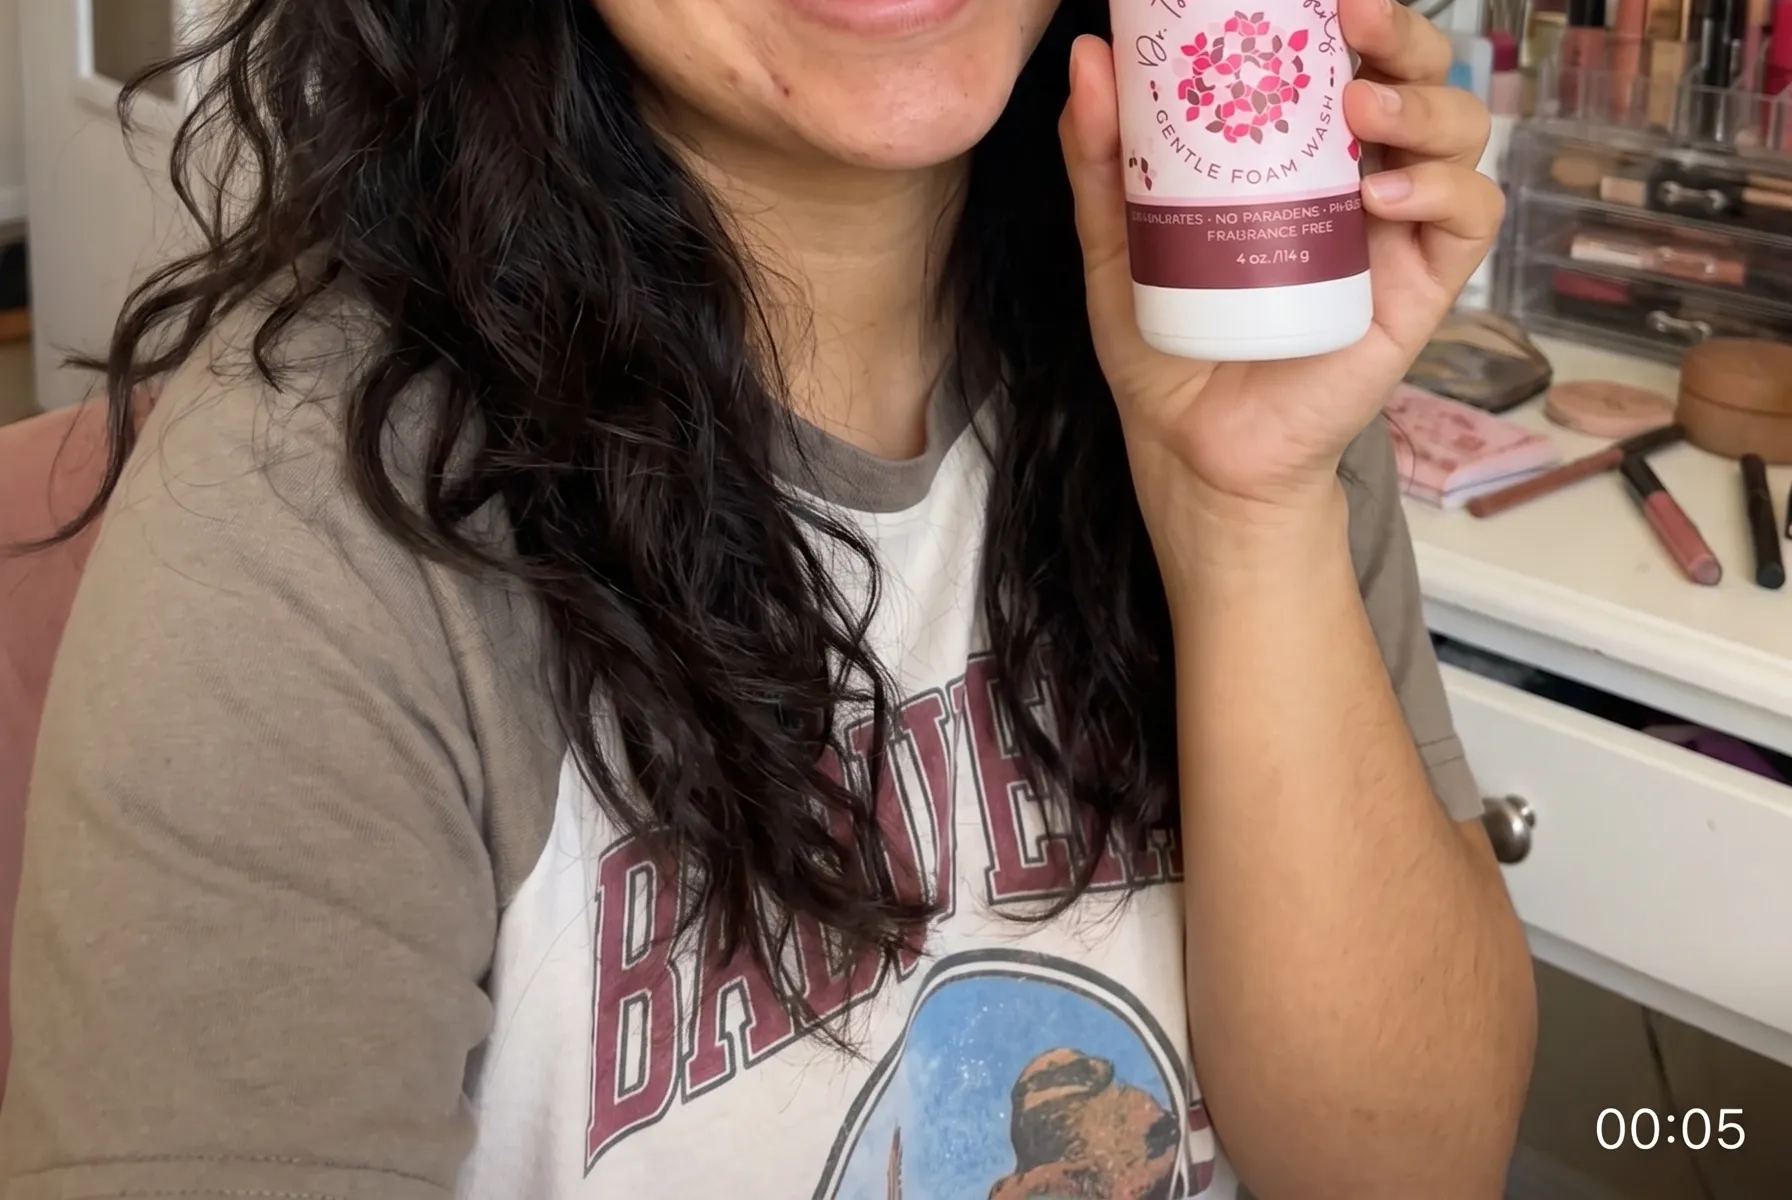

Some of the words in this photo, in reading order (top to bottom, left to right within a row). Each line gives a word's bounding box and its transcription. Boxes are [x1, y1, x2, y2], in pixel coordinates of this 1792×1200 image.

[1135, 28, 1168, 67] Dr.
[1156, 109, 1222, 180] GENTLE
[1231, 159, 1298, 184] FOAM
[1301, 95, 1334, 159] WASH
[1215, 212, 1238, 225] NO
[1302, 220, 1334, 235] FREE
[1236, 253, 1246, 265] 4
[1300, 250, 1310, 263] g
